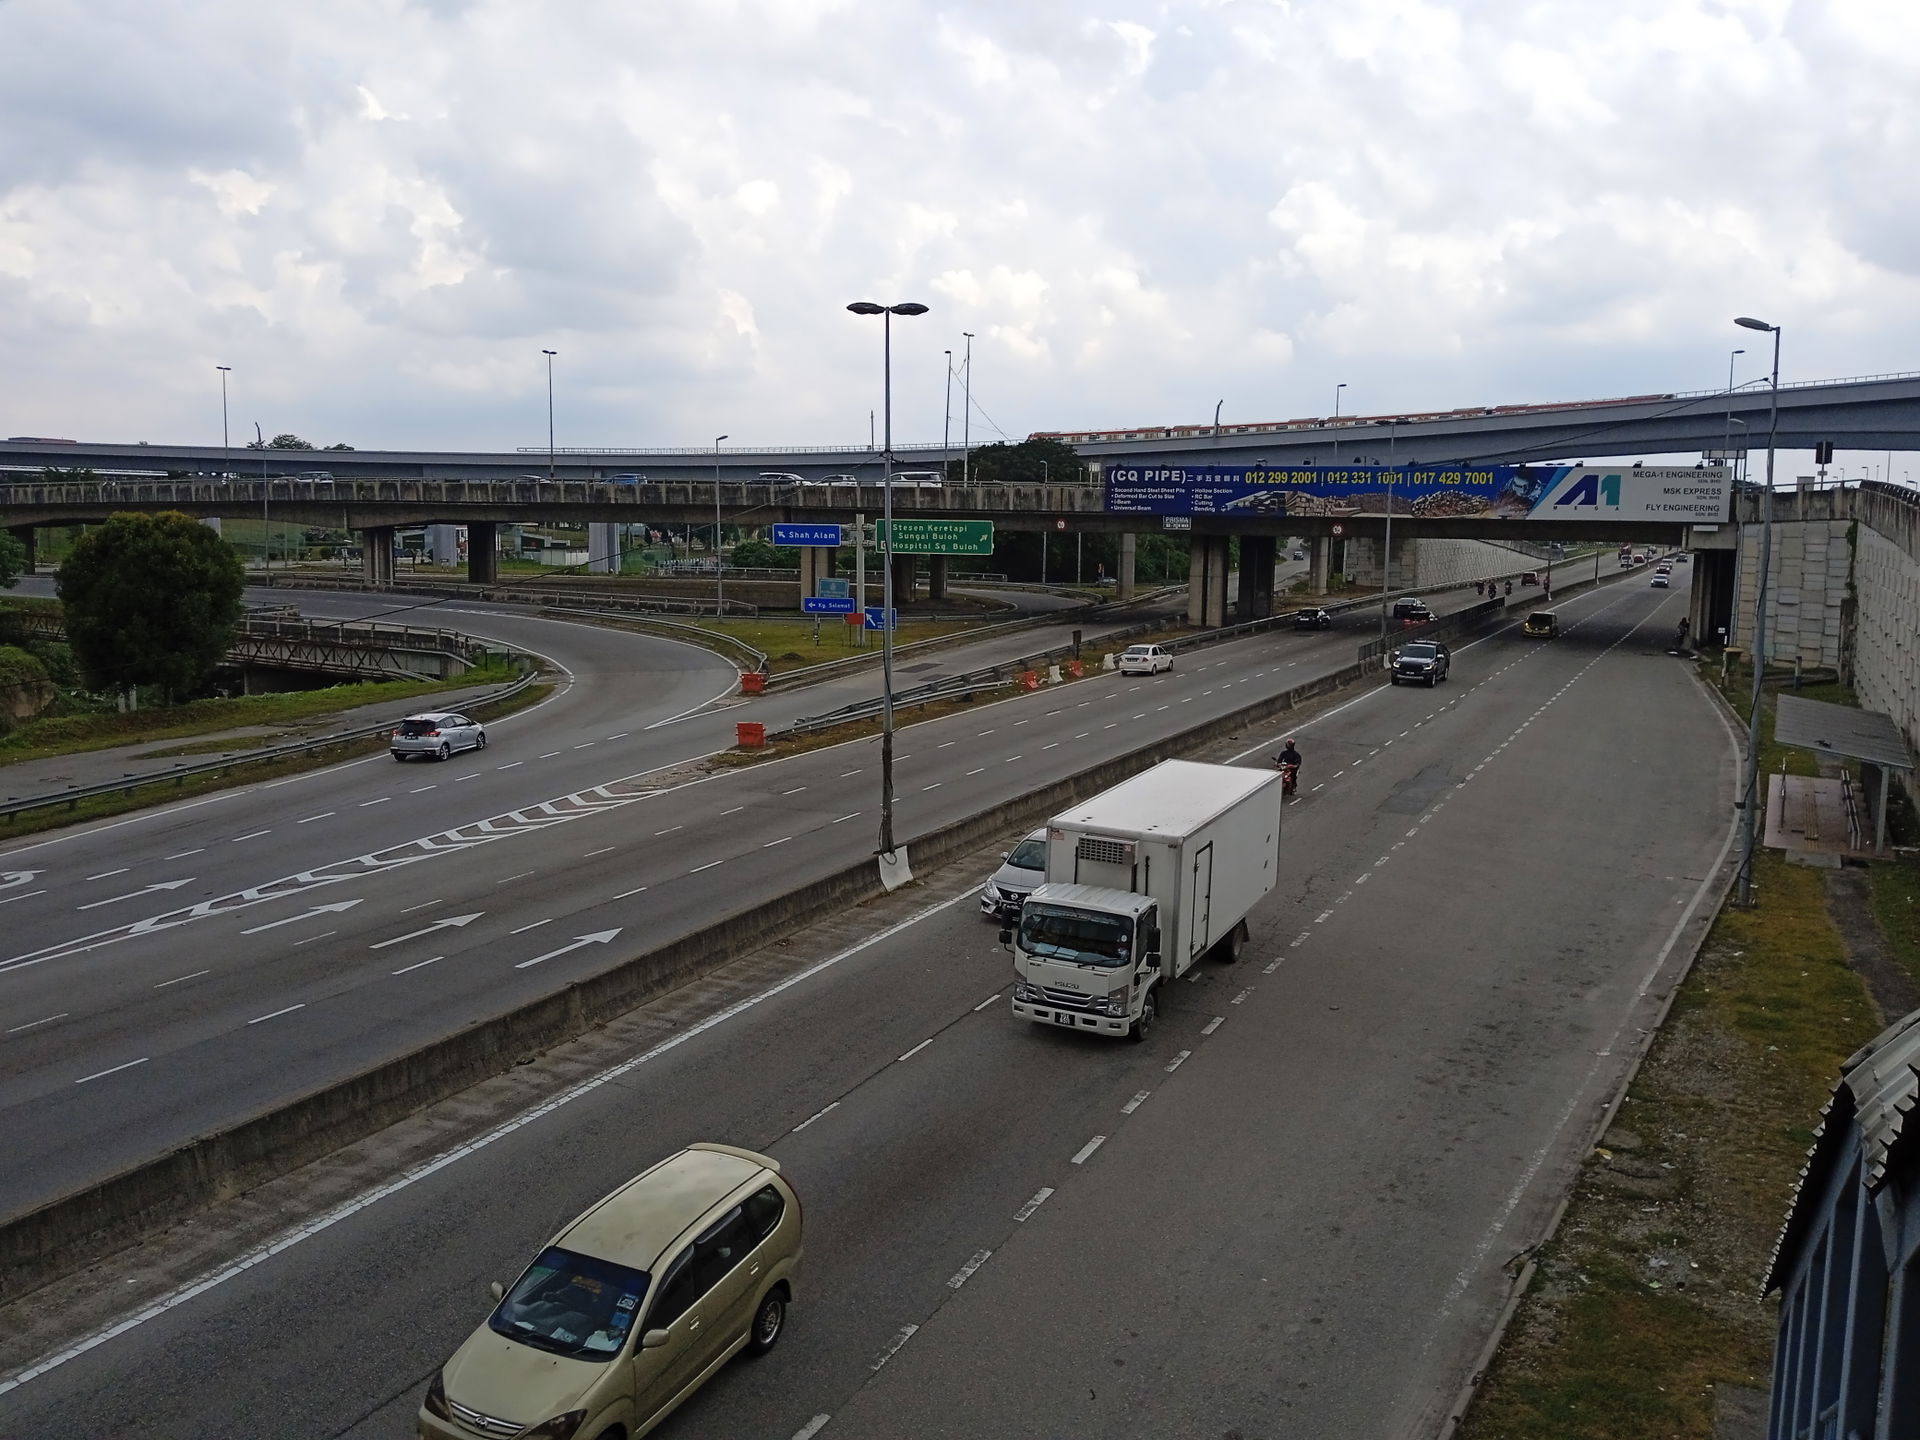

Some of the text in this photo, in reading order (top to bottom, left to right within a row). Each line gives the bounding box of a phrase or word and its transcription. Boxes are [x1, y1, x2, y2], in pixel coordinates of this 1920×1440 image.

[1111, 470, 1187, 484] (CQ PIPE)
[1245, 471, 1494, 485] 012 299 2001 012 331 1001 017 429 7001
[1665, 471, 1723, 479] ENGINEERING
[1663, 487, 1682, 495] MSK
[1645, 503, 1720, 512] FLY ENGINEERING
[892, 523, 968, 533] Stesen Keretapi
[788, 531, 810, 539] Shah
[898, 532, 929, 541] Sungai
[892, 542, 931, 551] Hospital
[1054, 980, 1080, 990] ISUZU
